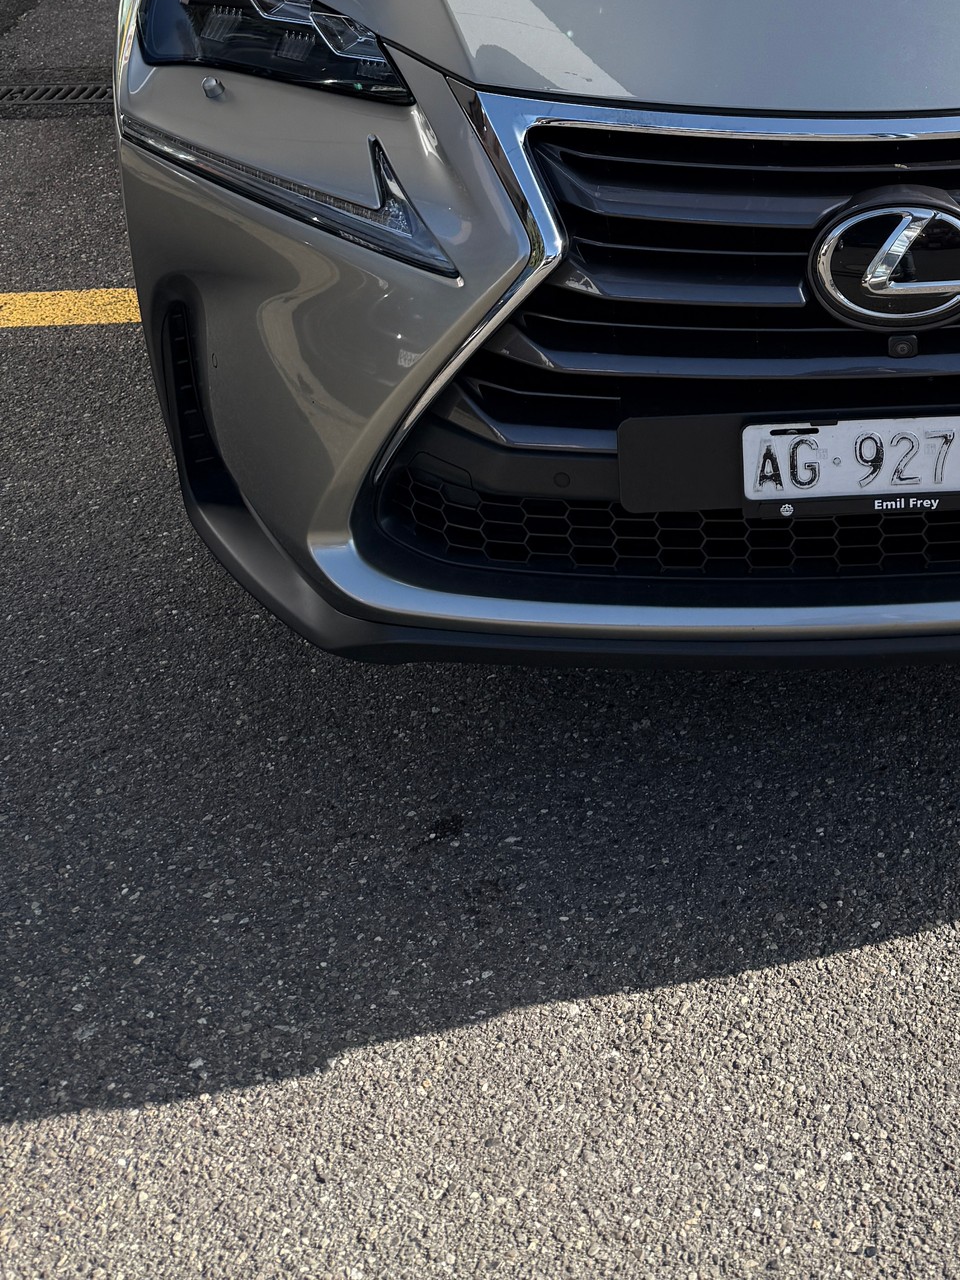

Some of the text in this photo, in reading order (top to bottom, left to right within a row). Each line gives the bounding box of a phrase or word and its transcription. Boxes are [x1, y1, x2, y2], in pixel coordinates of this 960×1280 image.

[753, 435, 821, 493] AG
[874, 497, 940, 510] Emil Frey
